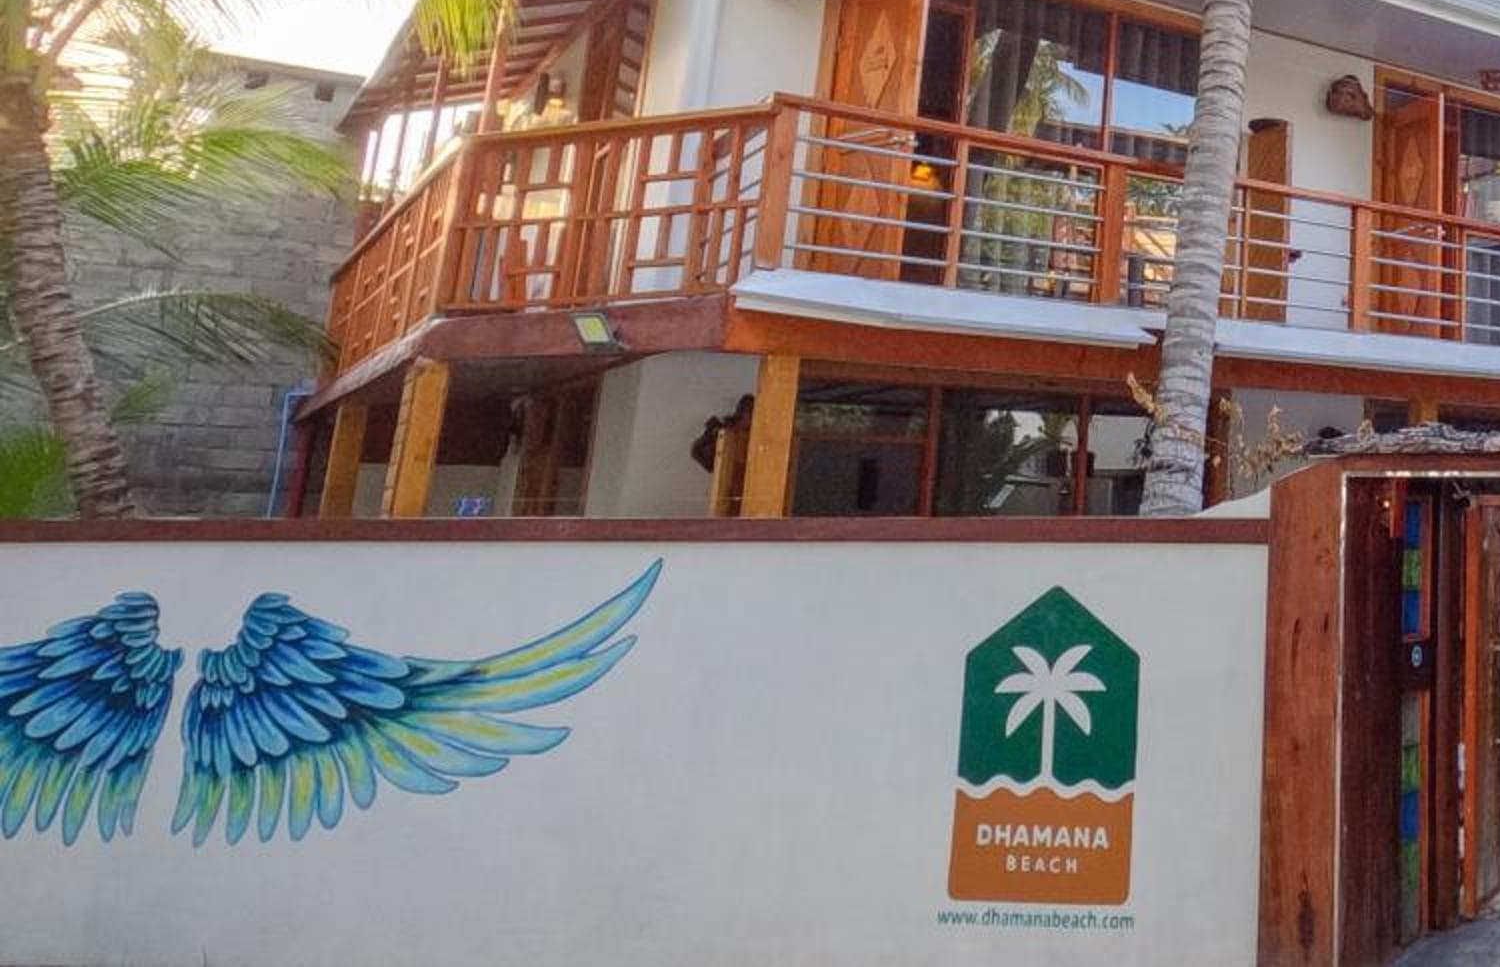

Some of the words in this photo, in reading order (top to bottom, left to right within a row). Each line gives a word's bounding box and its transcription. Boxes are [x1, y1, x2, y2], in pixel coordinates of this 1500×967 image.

[976, 824, 1109, 849] DHAMANA
[1006, 855, 1077, 873] BEACH
[937, 908, 1135, 929] www.dhamanabeach.com
